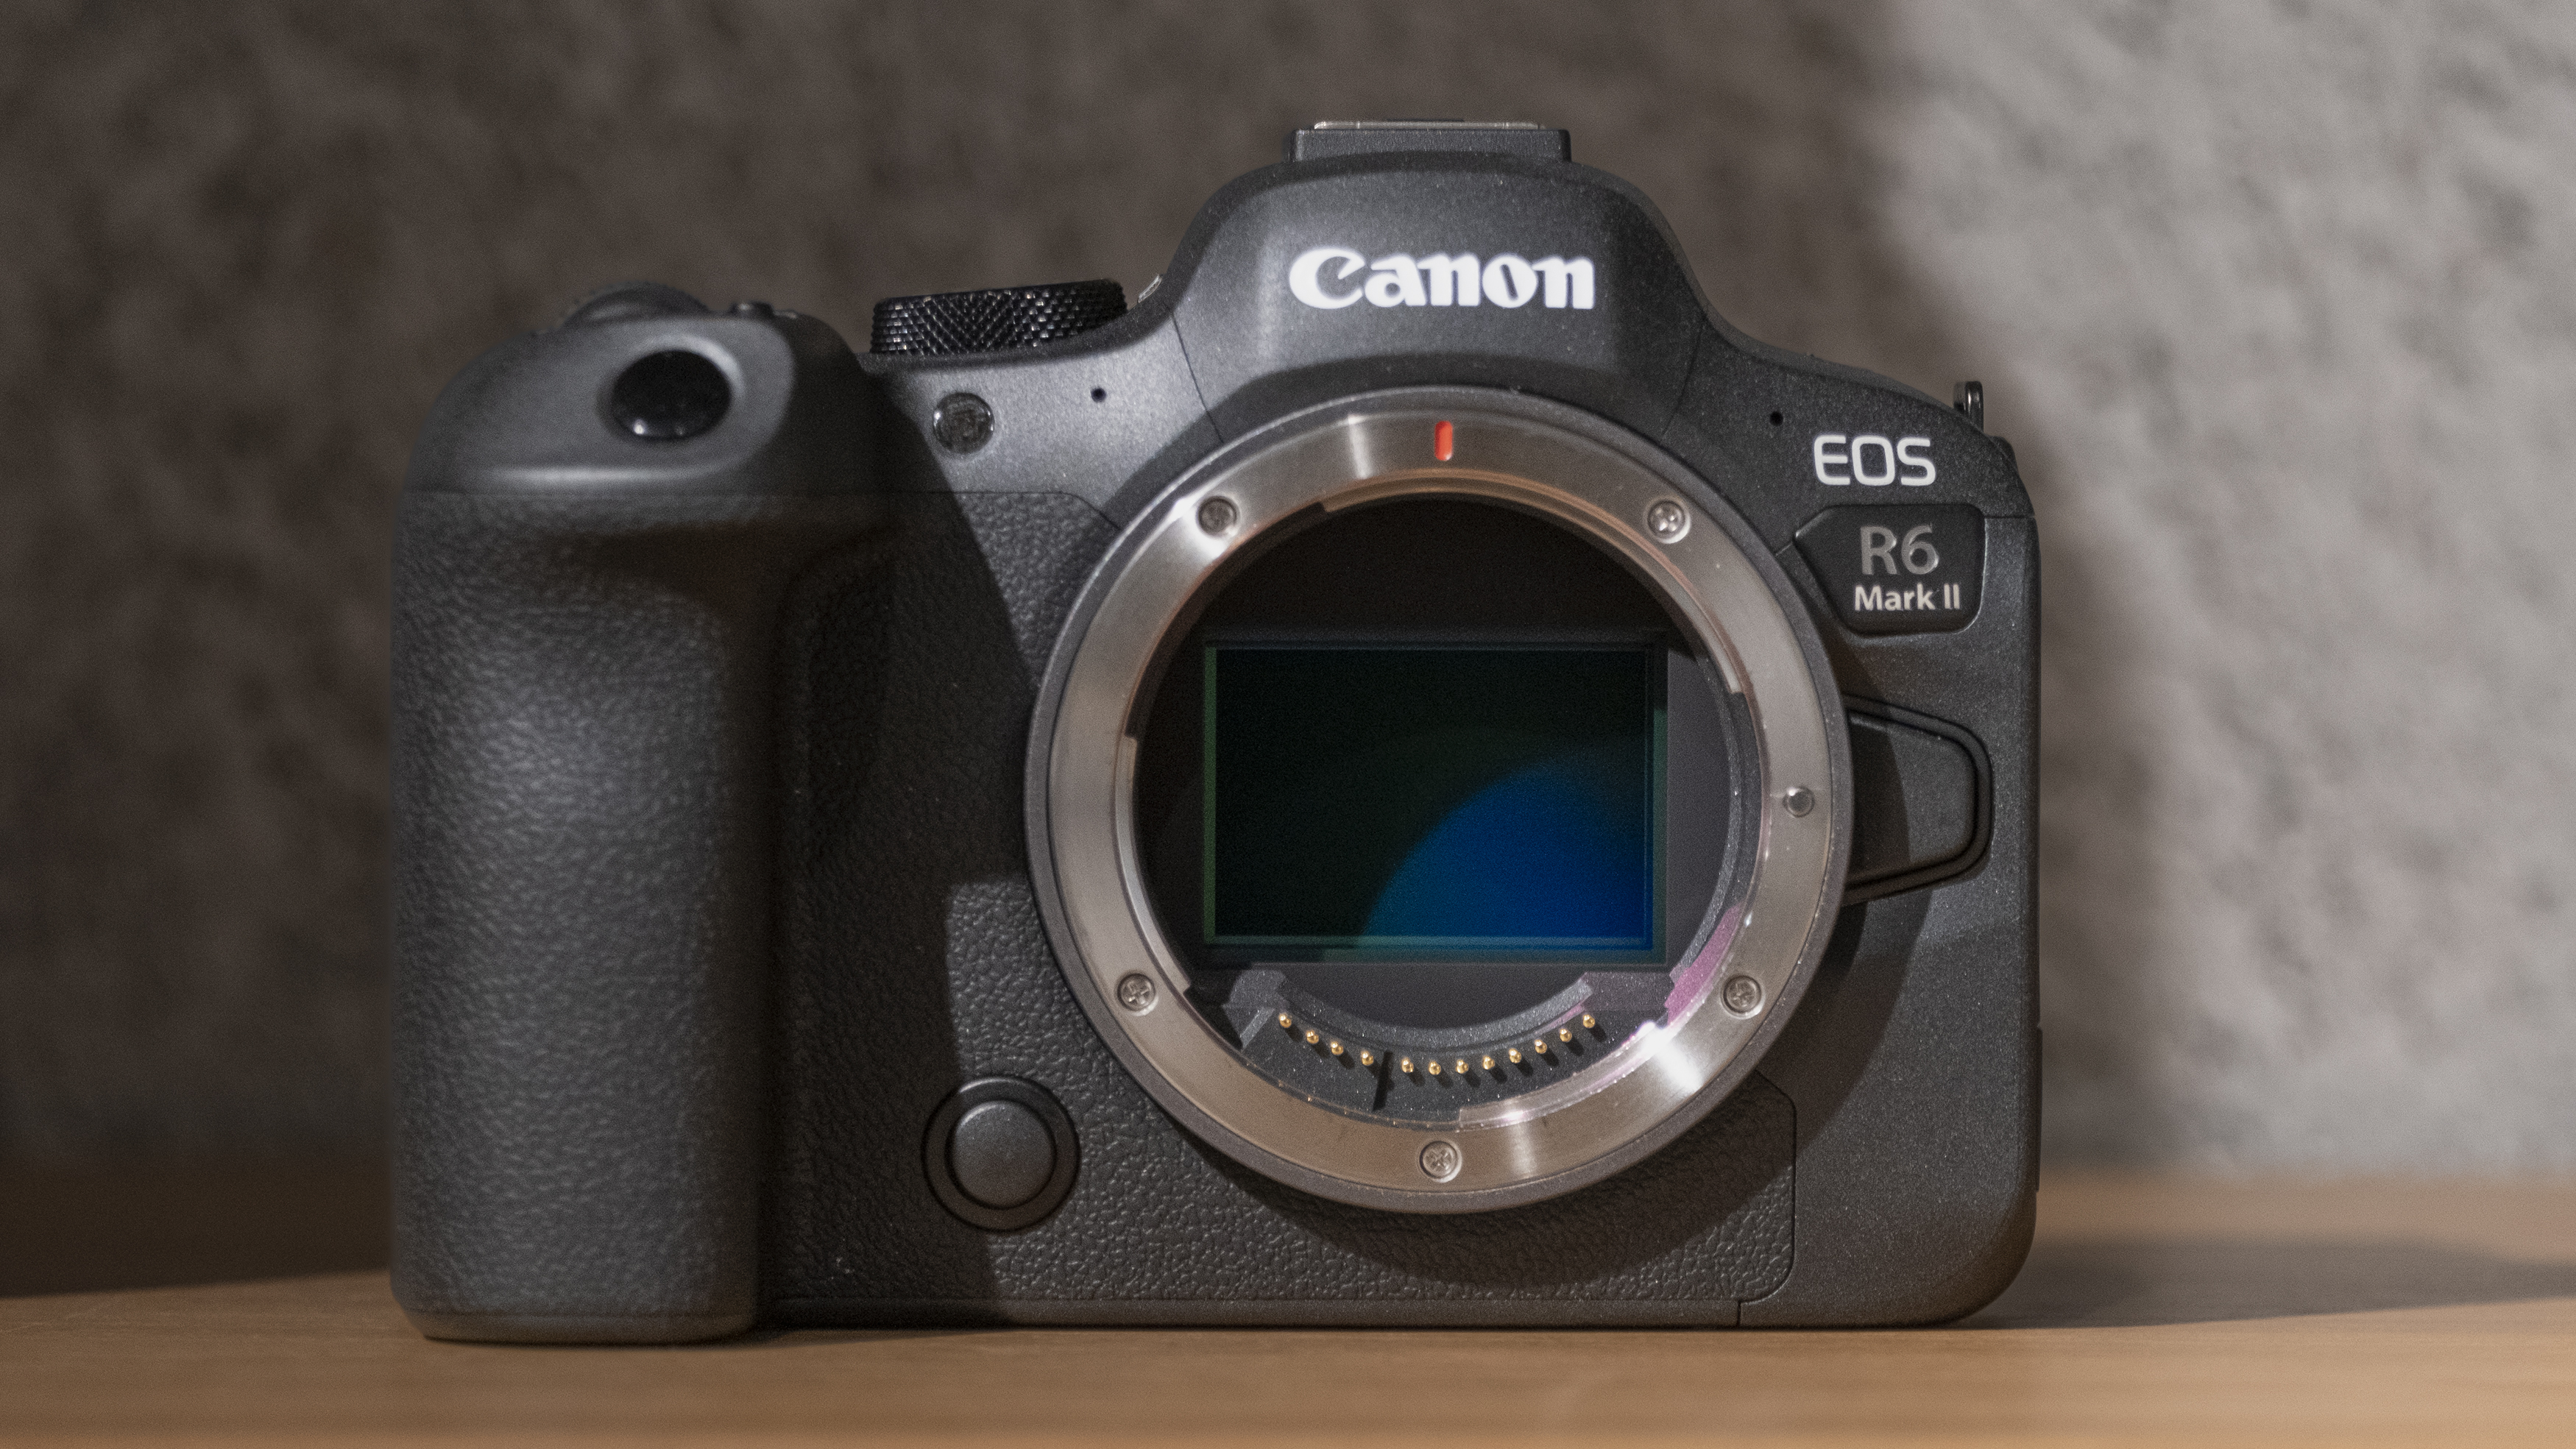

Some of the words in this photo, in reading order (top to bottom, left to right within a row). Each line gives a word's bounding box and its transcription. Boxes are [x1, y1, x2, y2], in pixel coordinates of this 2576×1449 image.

[1288, 245, 1596, 311] Canon
[1813, 434, 1937, 486] EOS
[1860, 525, 1940, 575] R6
[1854, 583, 1936, 612] Mark
[1943, 584, 1961, 610] II
